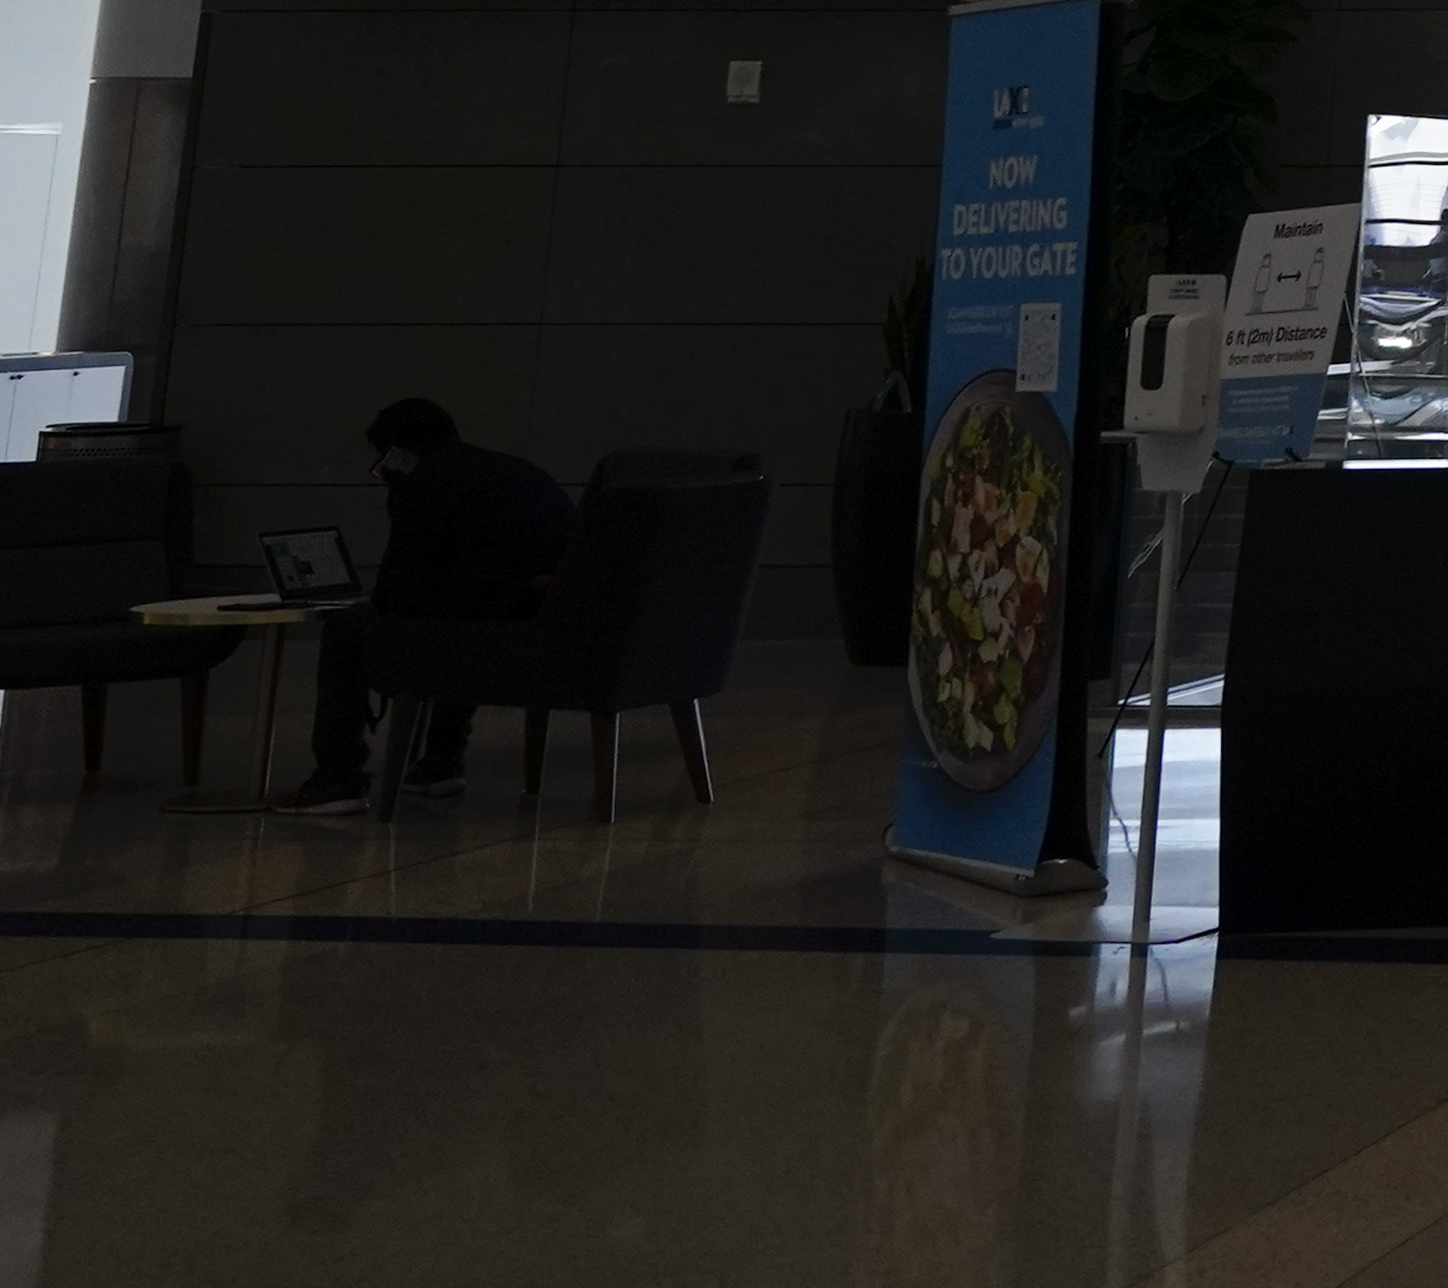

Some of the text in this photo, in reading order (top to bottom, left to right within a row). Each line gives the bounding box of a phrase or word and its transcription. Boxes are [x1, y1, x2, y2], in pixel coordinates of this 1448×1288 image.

[989, 154, 1038, 190] NOW
[953, 197, 1068, 236] DELIVERING
[1273, 218, 1324, 240] Maintain
[940, 241, 1078, 281] TO YOUR GATE
[1226, 325, 1329, 349] 6 ft (2m) Distance
[1228, 353, 1251, 367] from
[1252, 351, 1276, 365] other
